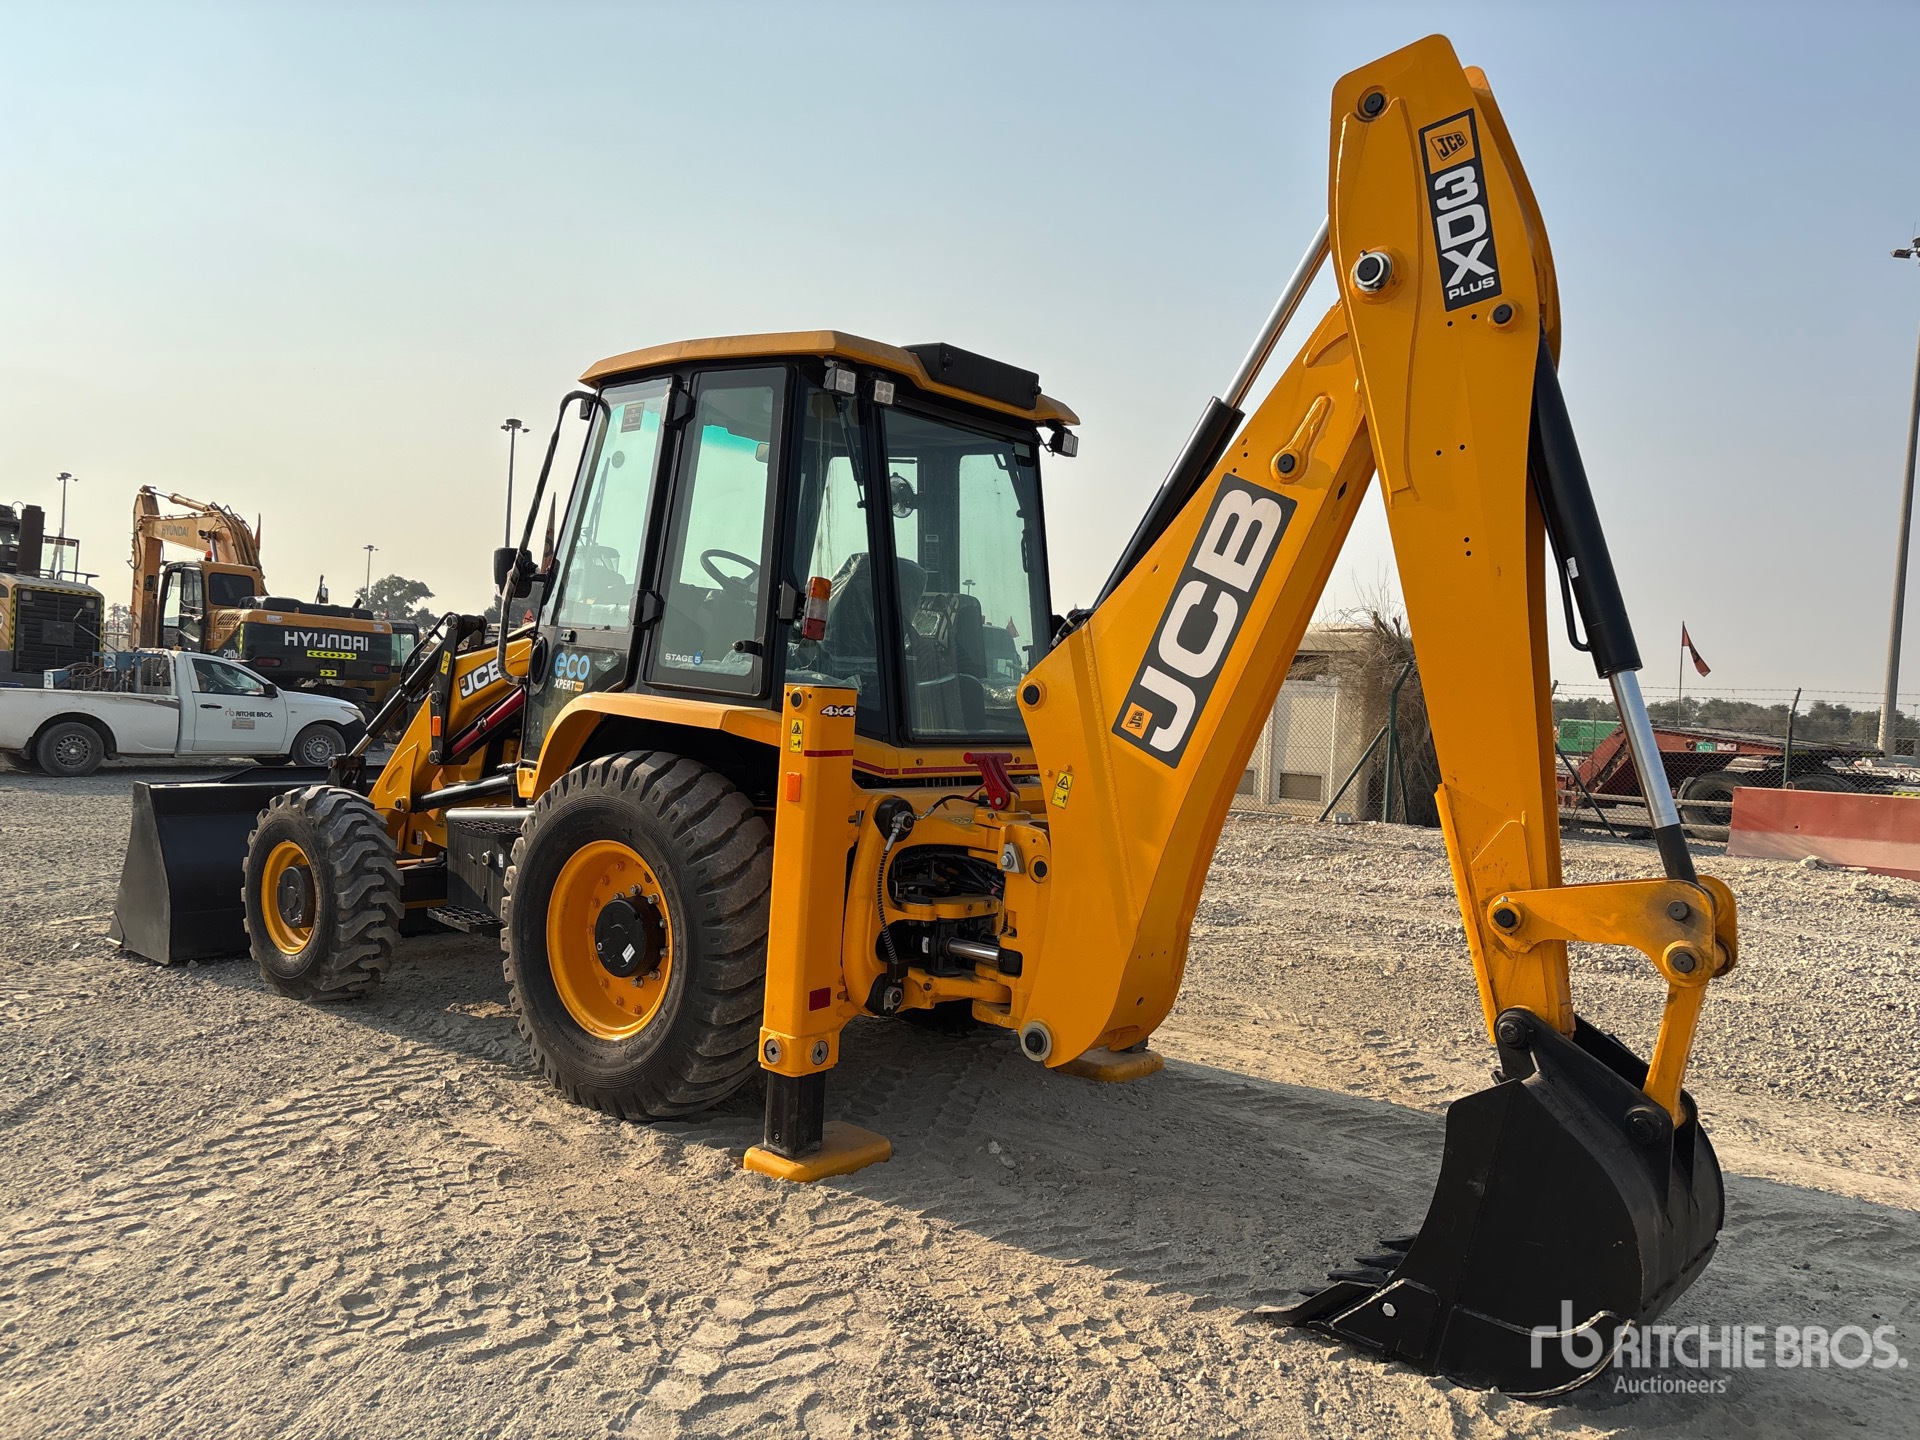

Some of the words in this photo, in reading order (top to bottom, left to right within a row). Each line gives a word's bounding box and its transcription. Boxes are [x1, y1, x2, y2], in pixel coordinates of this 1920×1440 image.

[1436, 132, 1466, 158] JCB
[1434, 165, 1496, 289] 3DX
[1448, 276, 1496, 300] PLUS
[1140, 489, 1282, 752] JCB
[284, 630, 369, 651] HYUNDAI
[554, 652, 590, 680] eco
[665, 653, 694, 662] STAGE
[554, 678, 575, 690] XPERT
